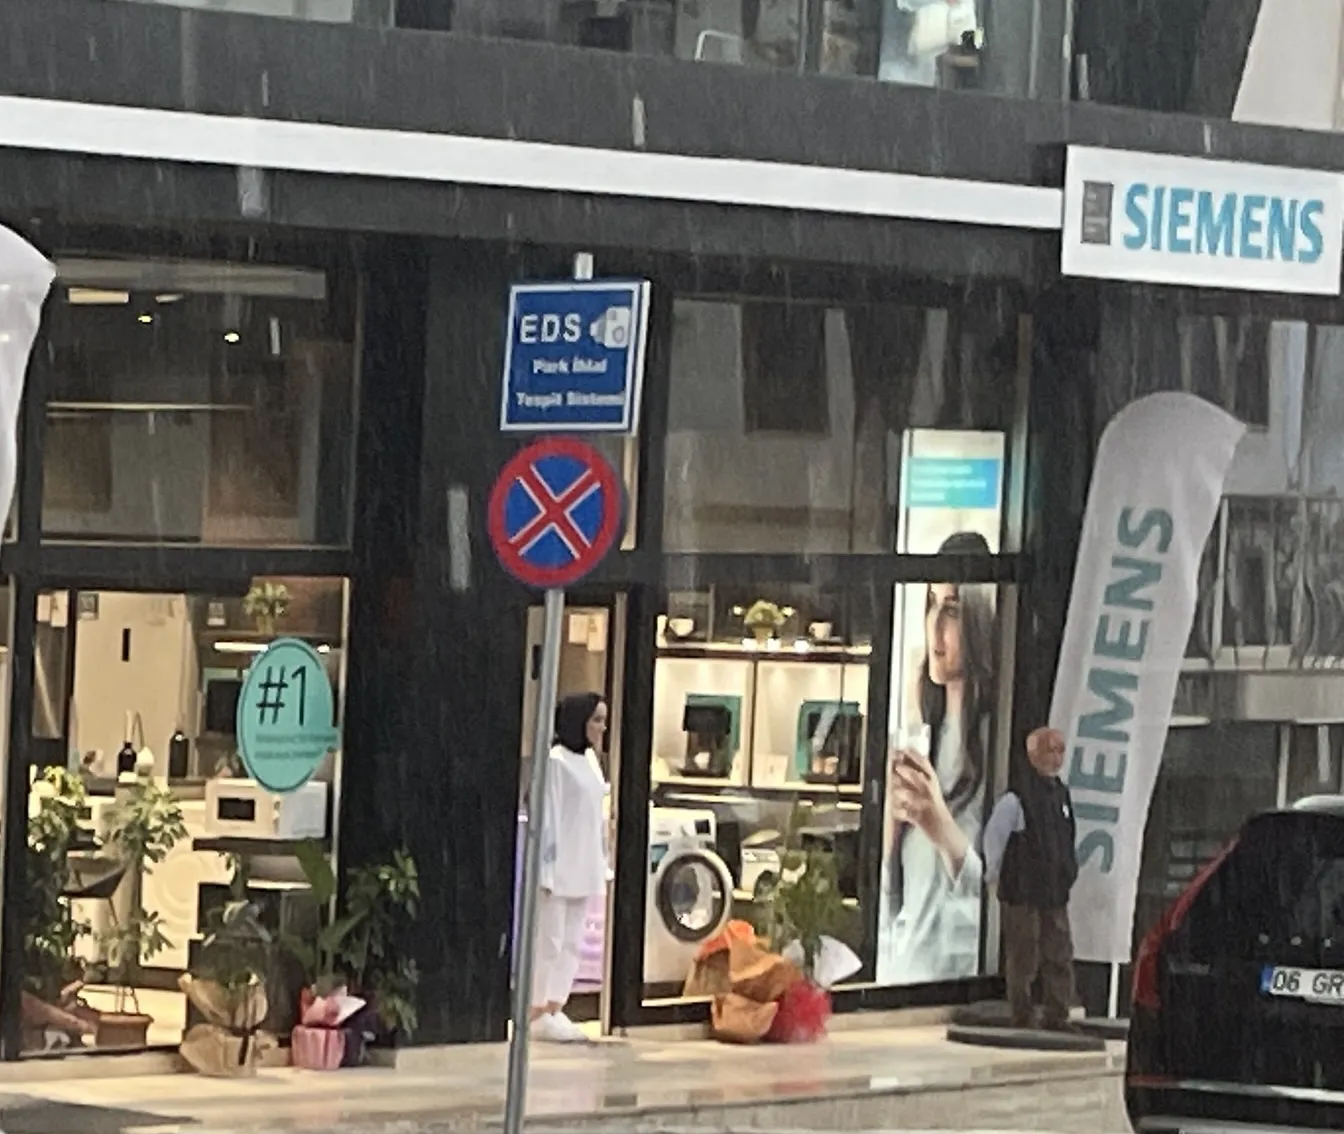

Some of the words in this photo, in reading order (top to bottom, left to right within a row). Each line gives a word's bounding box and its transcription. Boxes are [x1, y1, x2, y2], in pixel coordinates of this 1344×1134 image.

[1123, 182, 1325, 264] SIEMENS
[520, 313, 581, 343] EDS
[533, 358, 570, 374] Park
[516, 391, 562, 410] Tespit
[256, 664, 307, 727] #1
[1068, 504, 1174, 874] SIEMENS
[1272, 970, 1301, 992] 06
